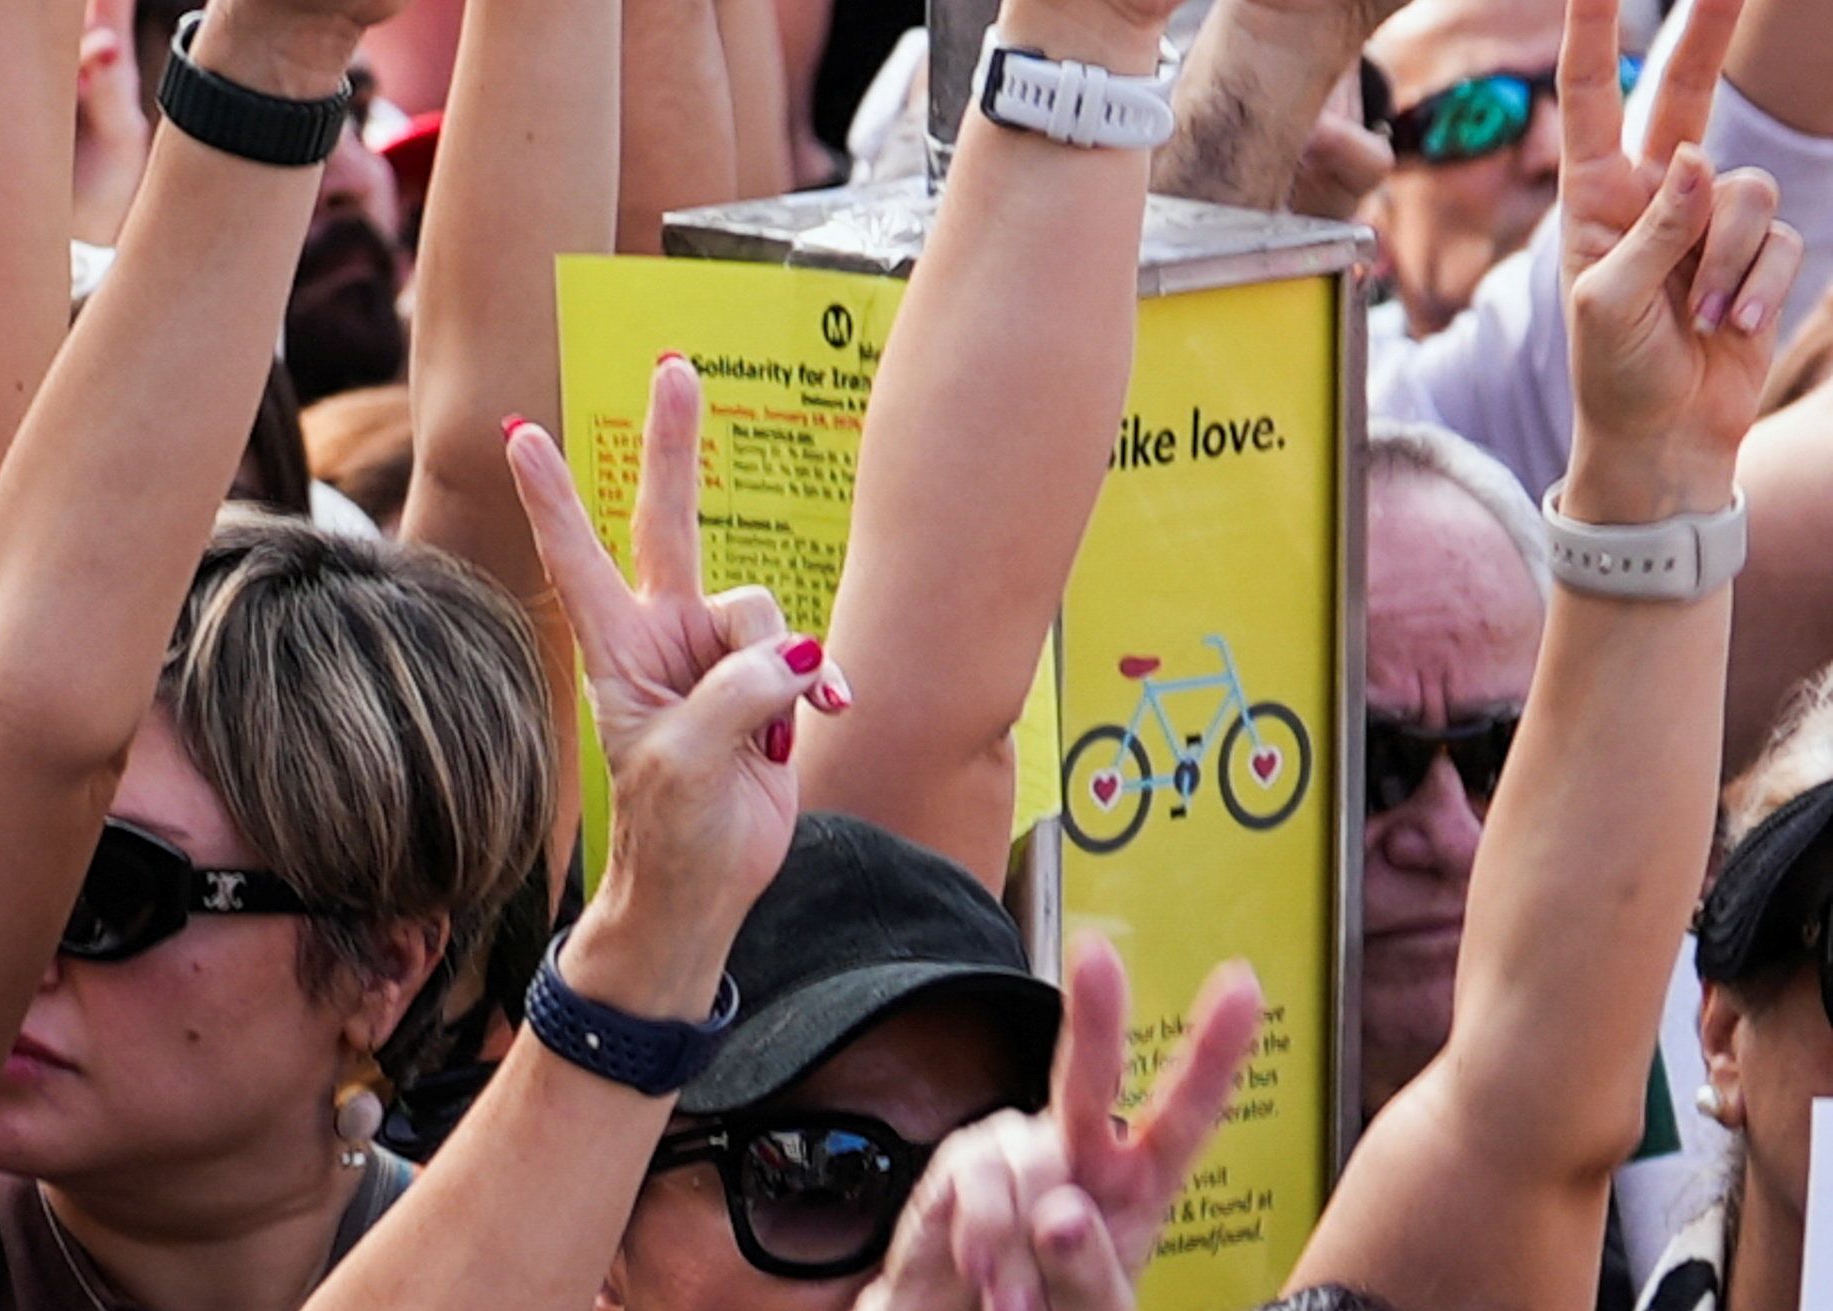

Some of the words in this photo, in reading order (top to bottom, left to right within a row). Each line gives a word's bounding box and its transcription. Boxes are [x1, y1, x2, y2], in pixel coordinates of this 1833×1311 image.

[691, 353, 793, 388] Solidarity
[799, 362, 826, 387] for
[1108, 414, 1176, 470] ike
[1191, 405, 1286, 461] love.
